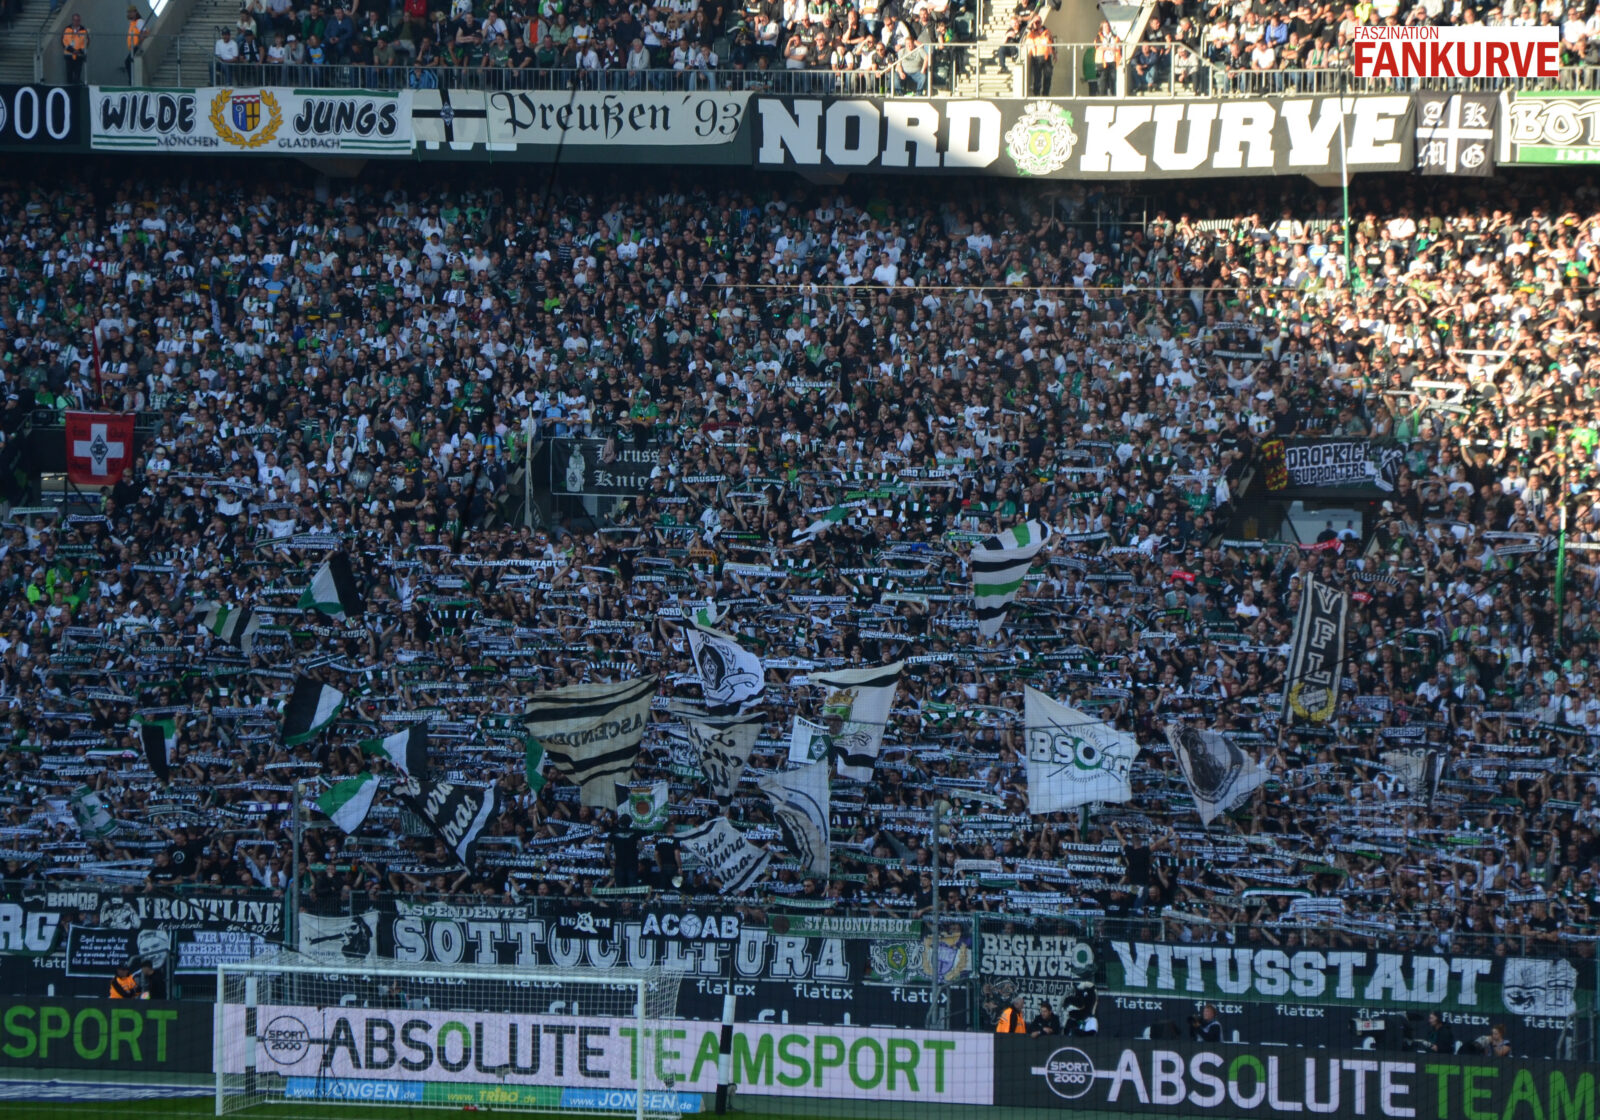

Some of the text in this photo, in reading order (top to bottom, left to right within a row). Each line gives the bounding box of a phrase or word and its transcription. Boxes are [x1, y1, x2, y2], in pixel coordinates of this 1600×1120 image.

[100, 93, 398, 136] WILDE JUNGS
[490, 91, 671, 139] Preußen
[157, 135, 340, 149] MÖNCHEN GLADBACH
[757, 96, 1410, 173] NORD KURVE
[1295, 463, 1367, 484] SUPPORTERS
[47, 892, 98, 907] BANDA
[136, 896, 282, 925] FRONTLINE
[399, 904, 528, 920] ASCENDENTE
[803, 917, 913, 933] STADIONVERBOT
[981, 933, 1077, 957] BEGLEIT
[980, 955, 1073, 978] SERVICE
[1110, 941, 1492, 1005] VITUSSTADT
[793, 983, 854, 1000] flatex
[891, 987, 948, 1003] flatx
[1115, 998, 1162, 1011] flatex
[1195, 1000, 1243, 1014] fltex
[1275, 1004, 1325, 1017] flatex
[1441, 1011, 1491, 1025] flatex
[1, 1005, 178, 1062] SPORT
[268, 1030, 304, 1039] SPORT
[271, 1040, 302, 1051] 2000
[325, 1017, 956, 1093] ABSOLUTE TEAMSPORT
[1050, 1061, 1090, 1072] SPORT
[1053, 1073, 1086, 1084] 2000
[1107, 1048, 1416, 1118] ABSOLUTE
